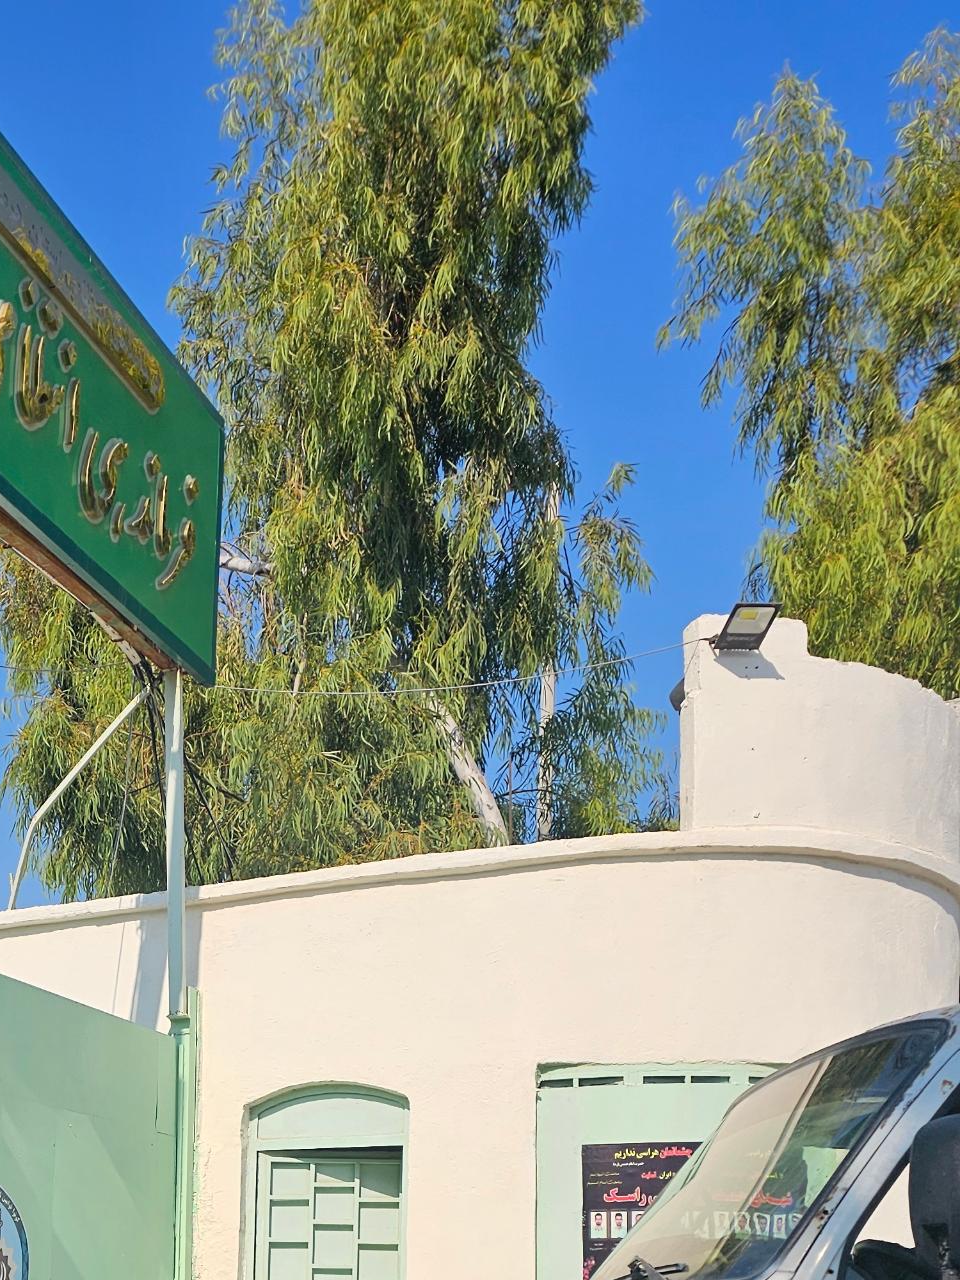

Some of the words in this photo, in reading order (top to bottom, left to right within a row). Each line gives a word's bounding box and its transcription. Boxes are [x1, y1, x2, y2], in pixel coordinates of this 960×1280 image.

[77, 427, 200, 591] فرماندهی
[614, 1147, 637, 1160] نداریم
[636, 1148, 659, 1159] هراسی
[659, 1170, 672, 1180] ایران
[603, 1186, 647, 1207] راسک
